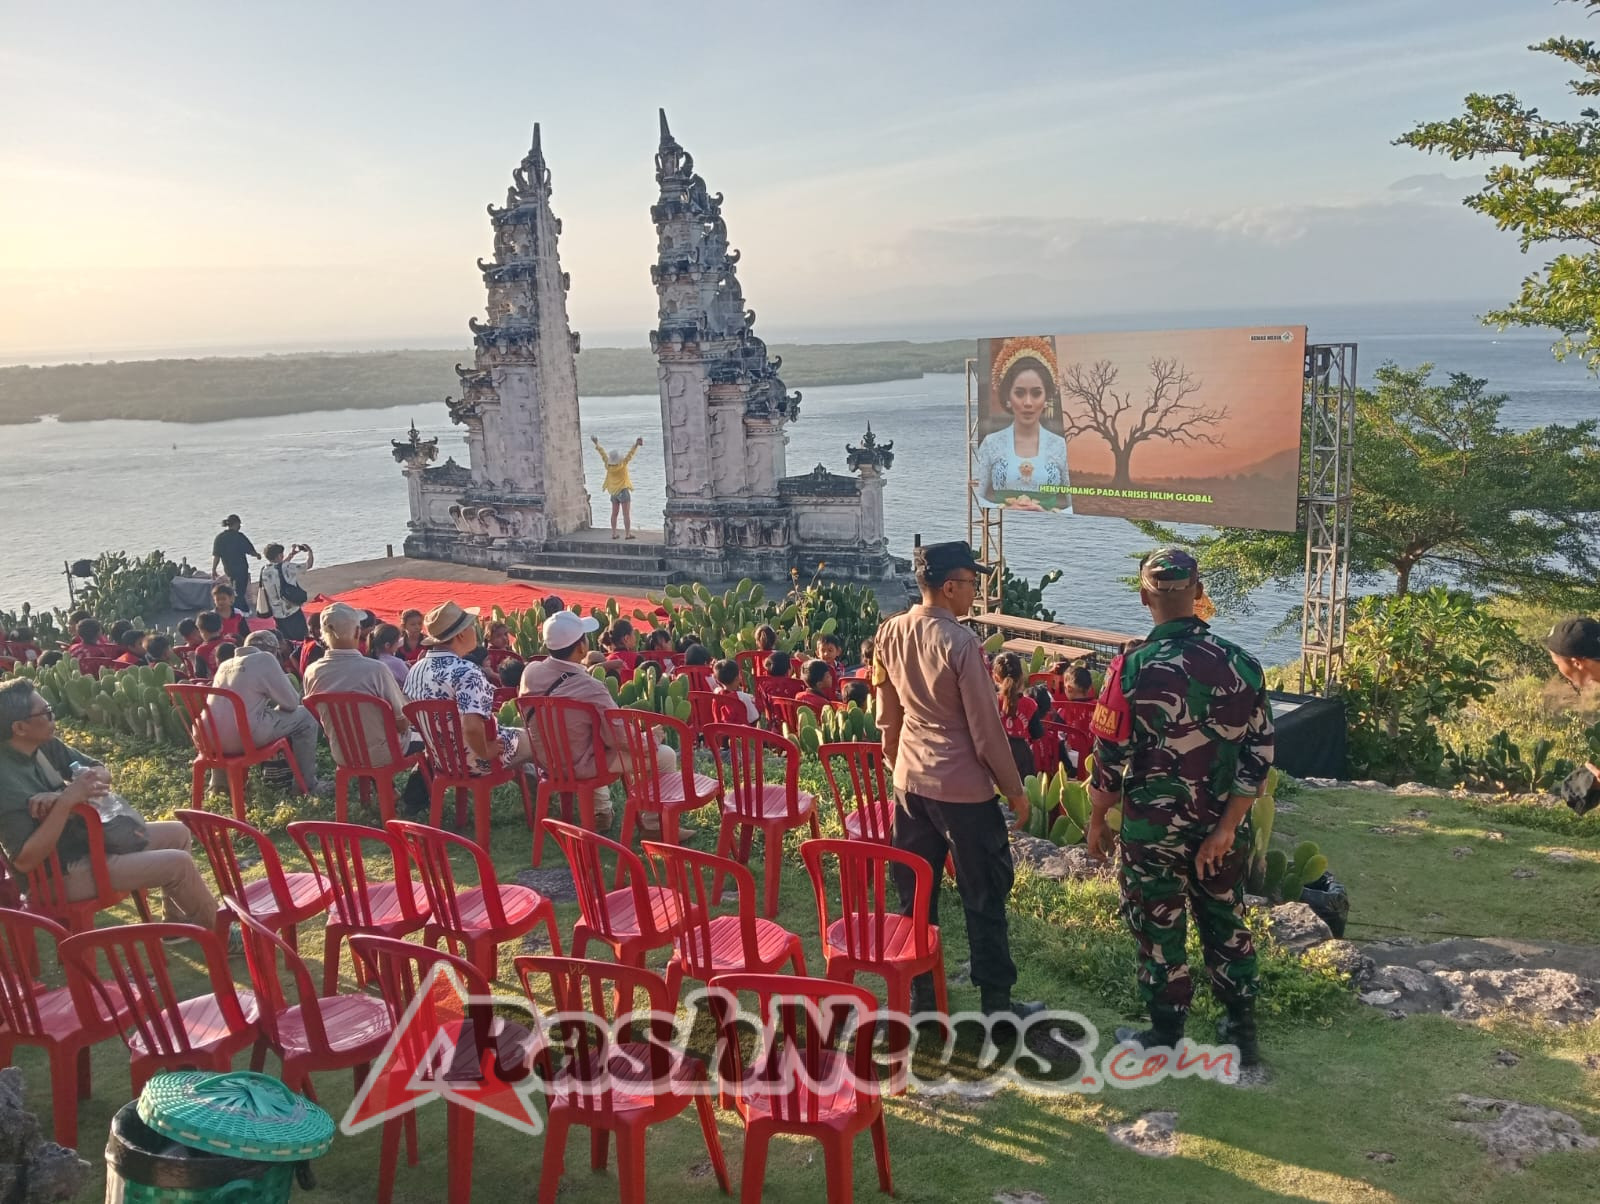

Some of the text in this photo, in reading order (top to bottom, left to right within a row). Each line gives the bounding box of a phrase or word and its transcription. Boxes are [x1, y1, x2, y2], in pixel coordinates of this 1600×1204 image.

[1039, 485, 1213, 503] MENYUMBANG PADA KRISIS IKLIM GLOBAL
